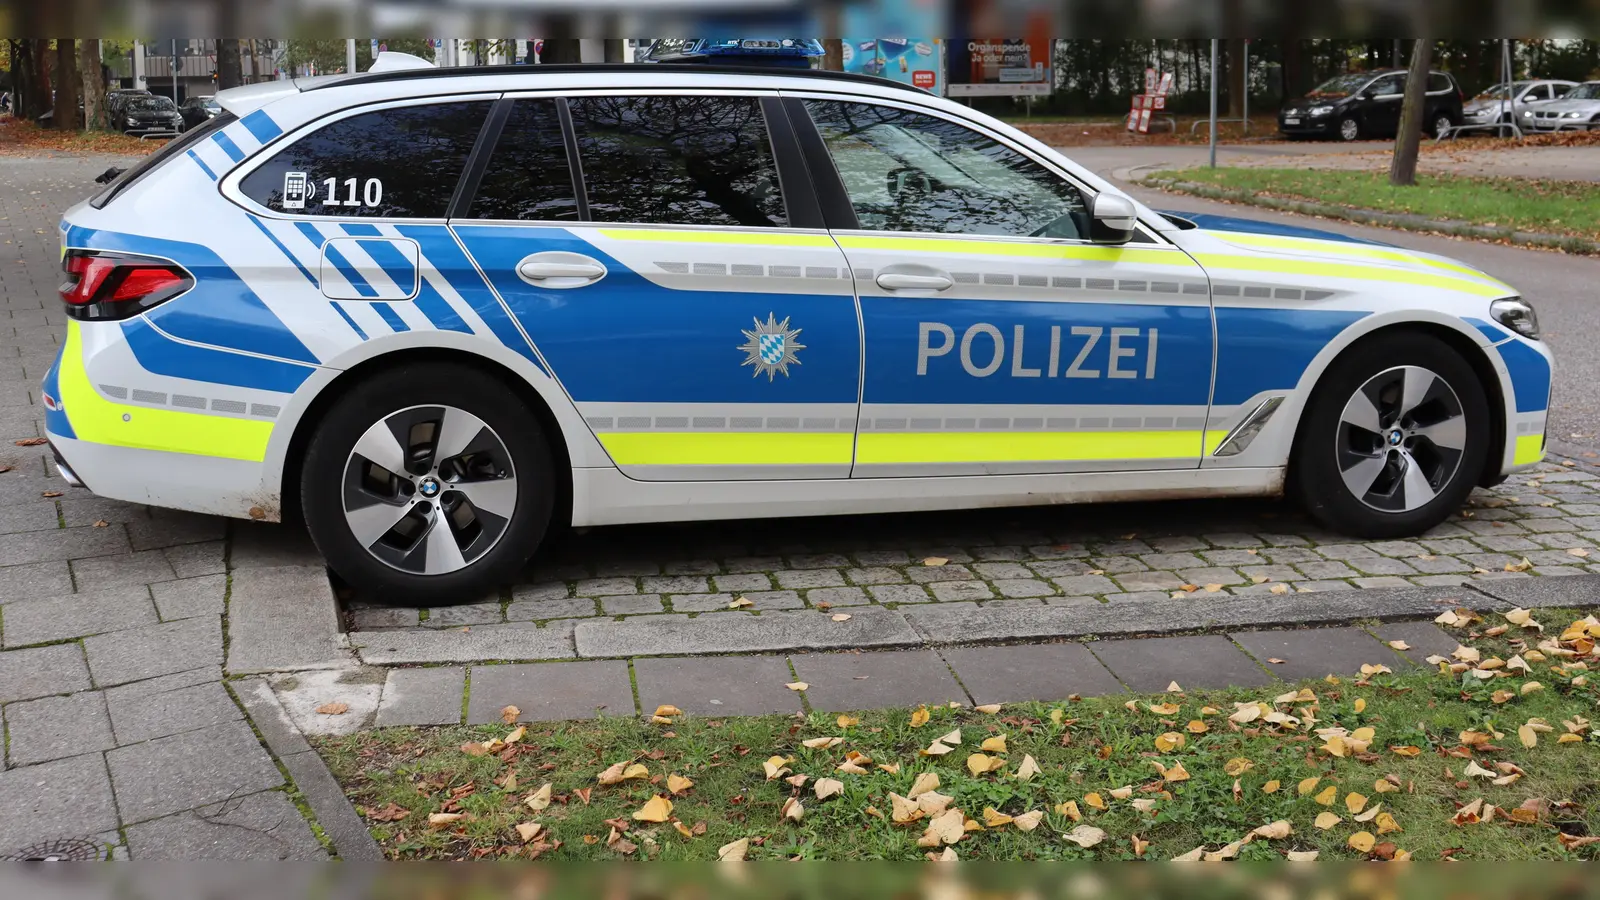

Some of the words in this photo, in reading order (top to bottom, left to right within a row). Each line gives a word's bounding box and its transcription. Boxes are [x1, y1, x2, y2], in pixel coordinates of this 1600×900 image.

[967, 42, 1031, 53] Organspende
[971, 53, 981, 62] Ja
[983, 53, 1003, 62] oder
[1004, 53, 1027, 62] nein?
[322, 177, 383, 207] 110
[916, 322, 1158, 379] POLIZEI
